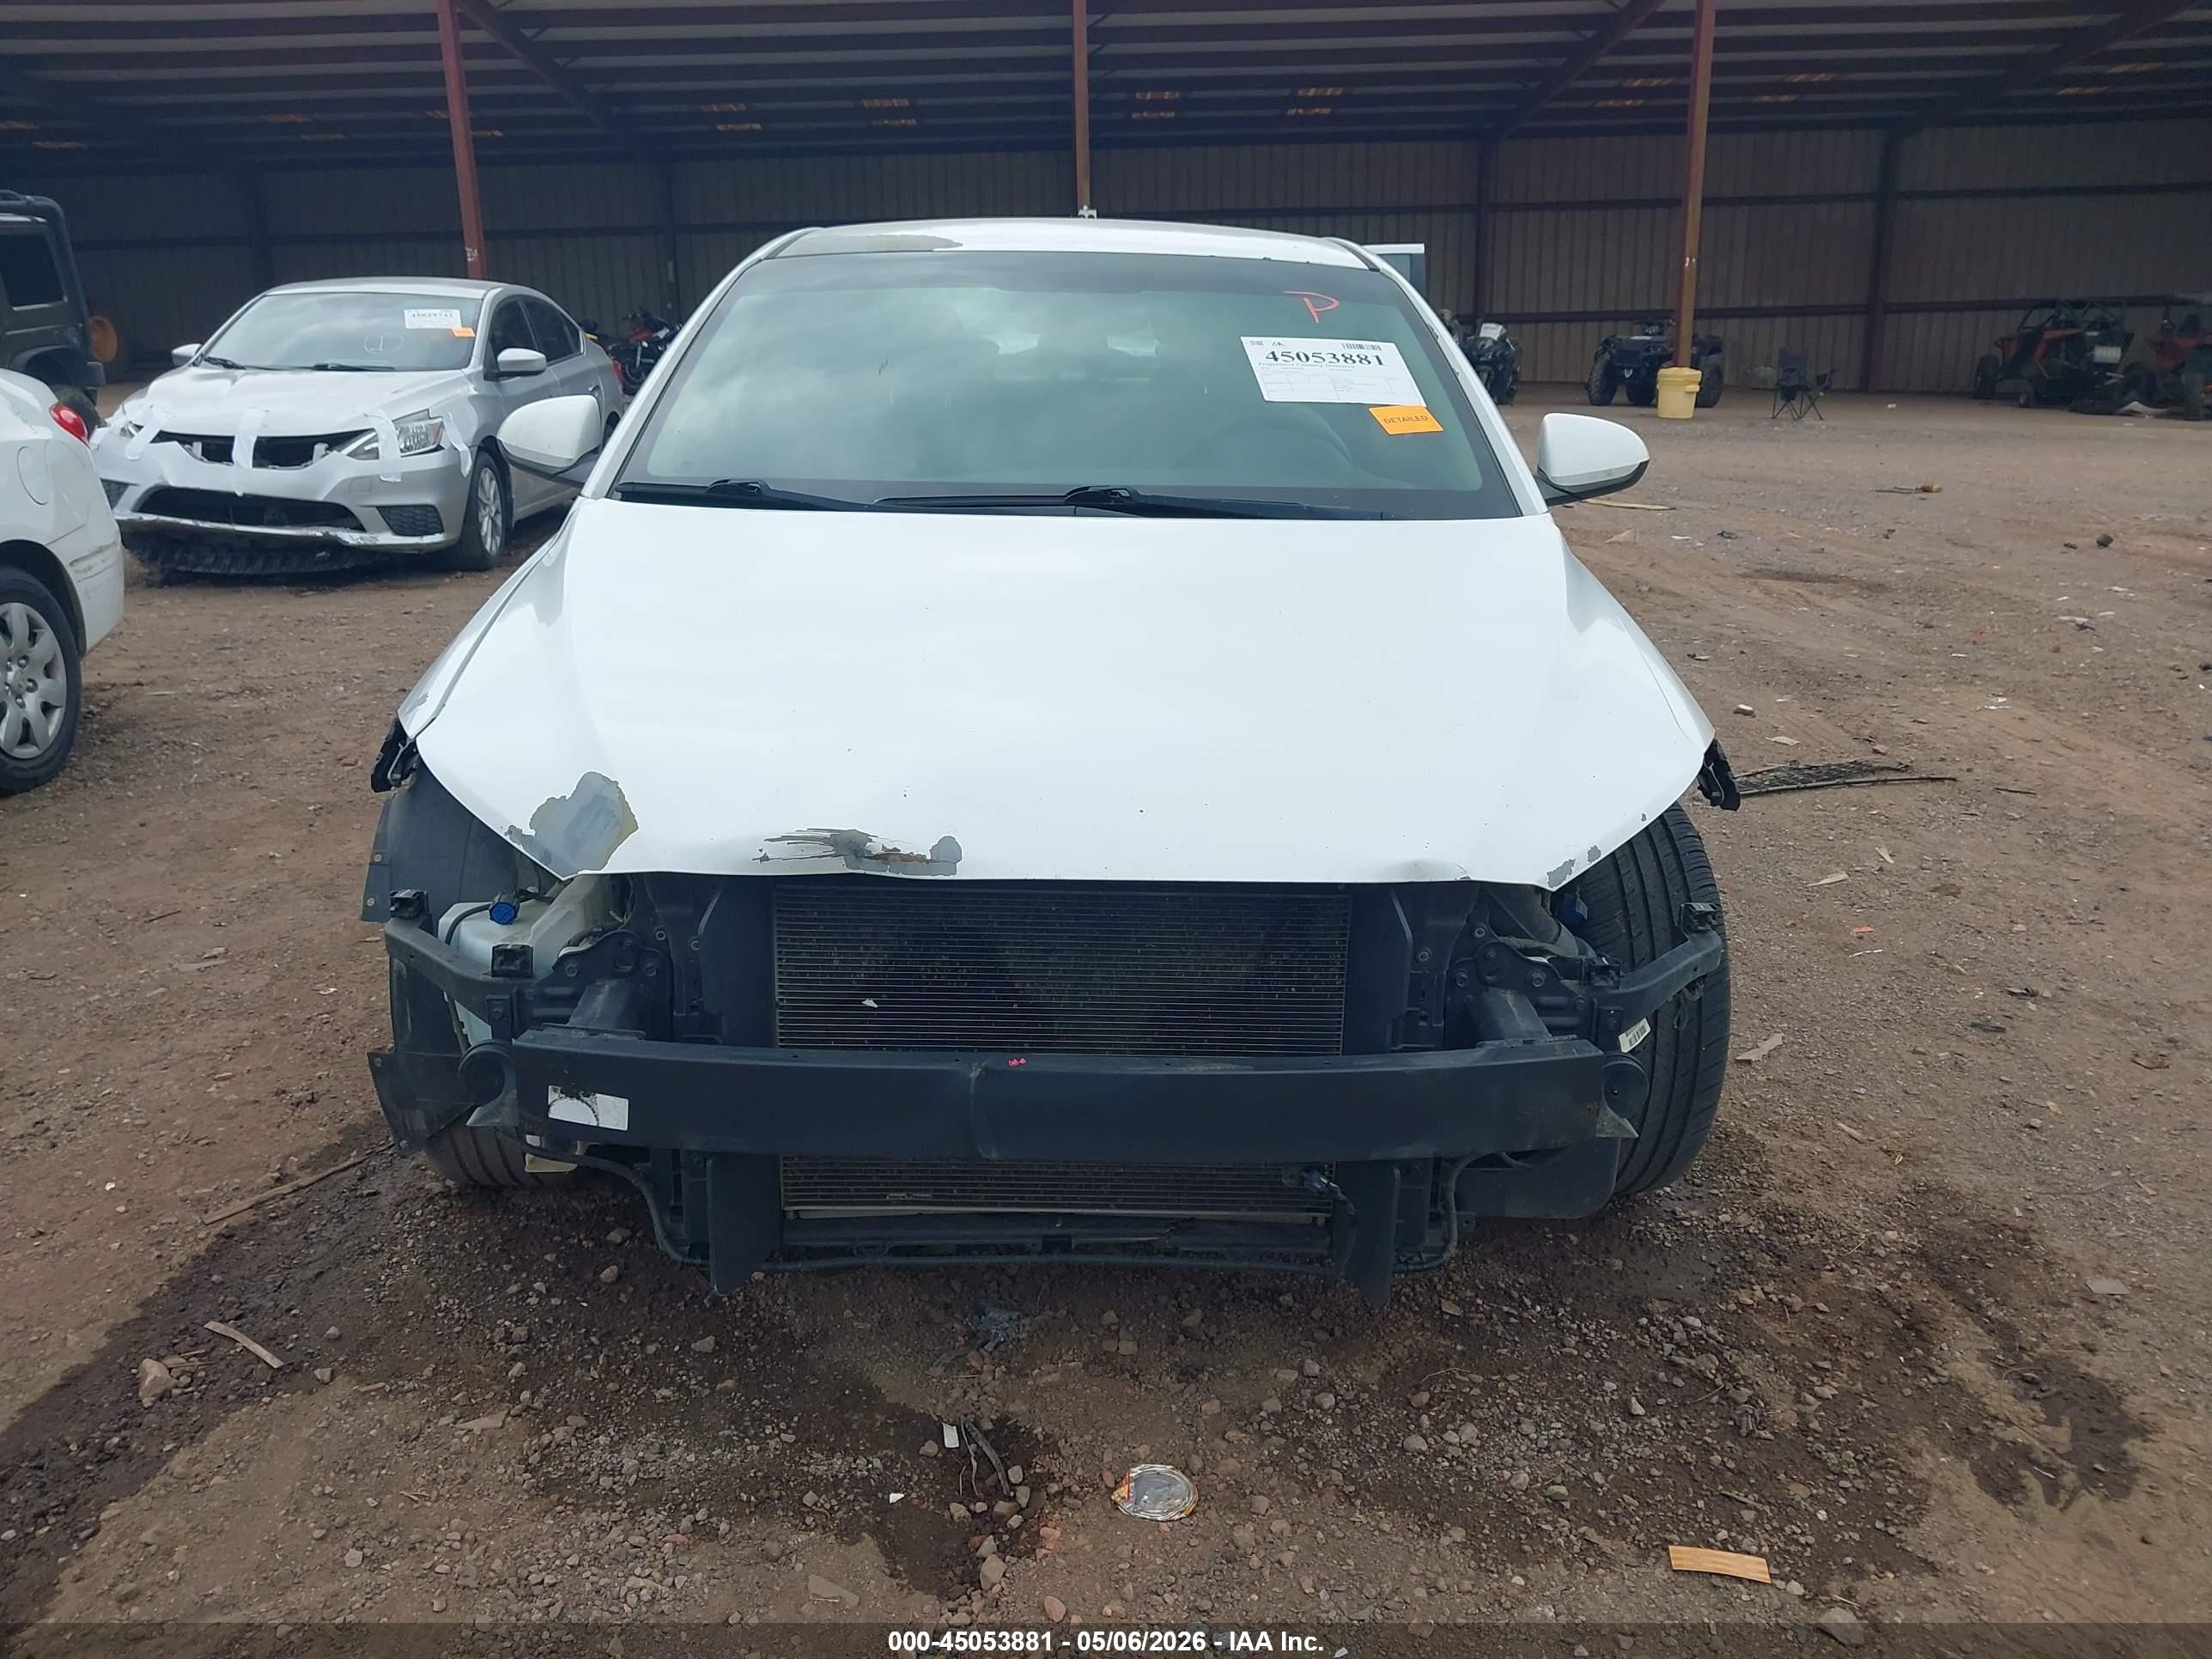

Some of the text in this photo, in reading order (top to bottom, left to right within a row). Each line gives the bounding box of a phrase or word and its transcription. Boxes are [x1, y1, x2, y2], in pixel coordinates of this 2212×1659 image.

[1283, 290, 1340, 324] P
[1265, 350, 1385, 366] 45053881
[1383, 415, 1429, 424] DETAILED
